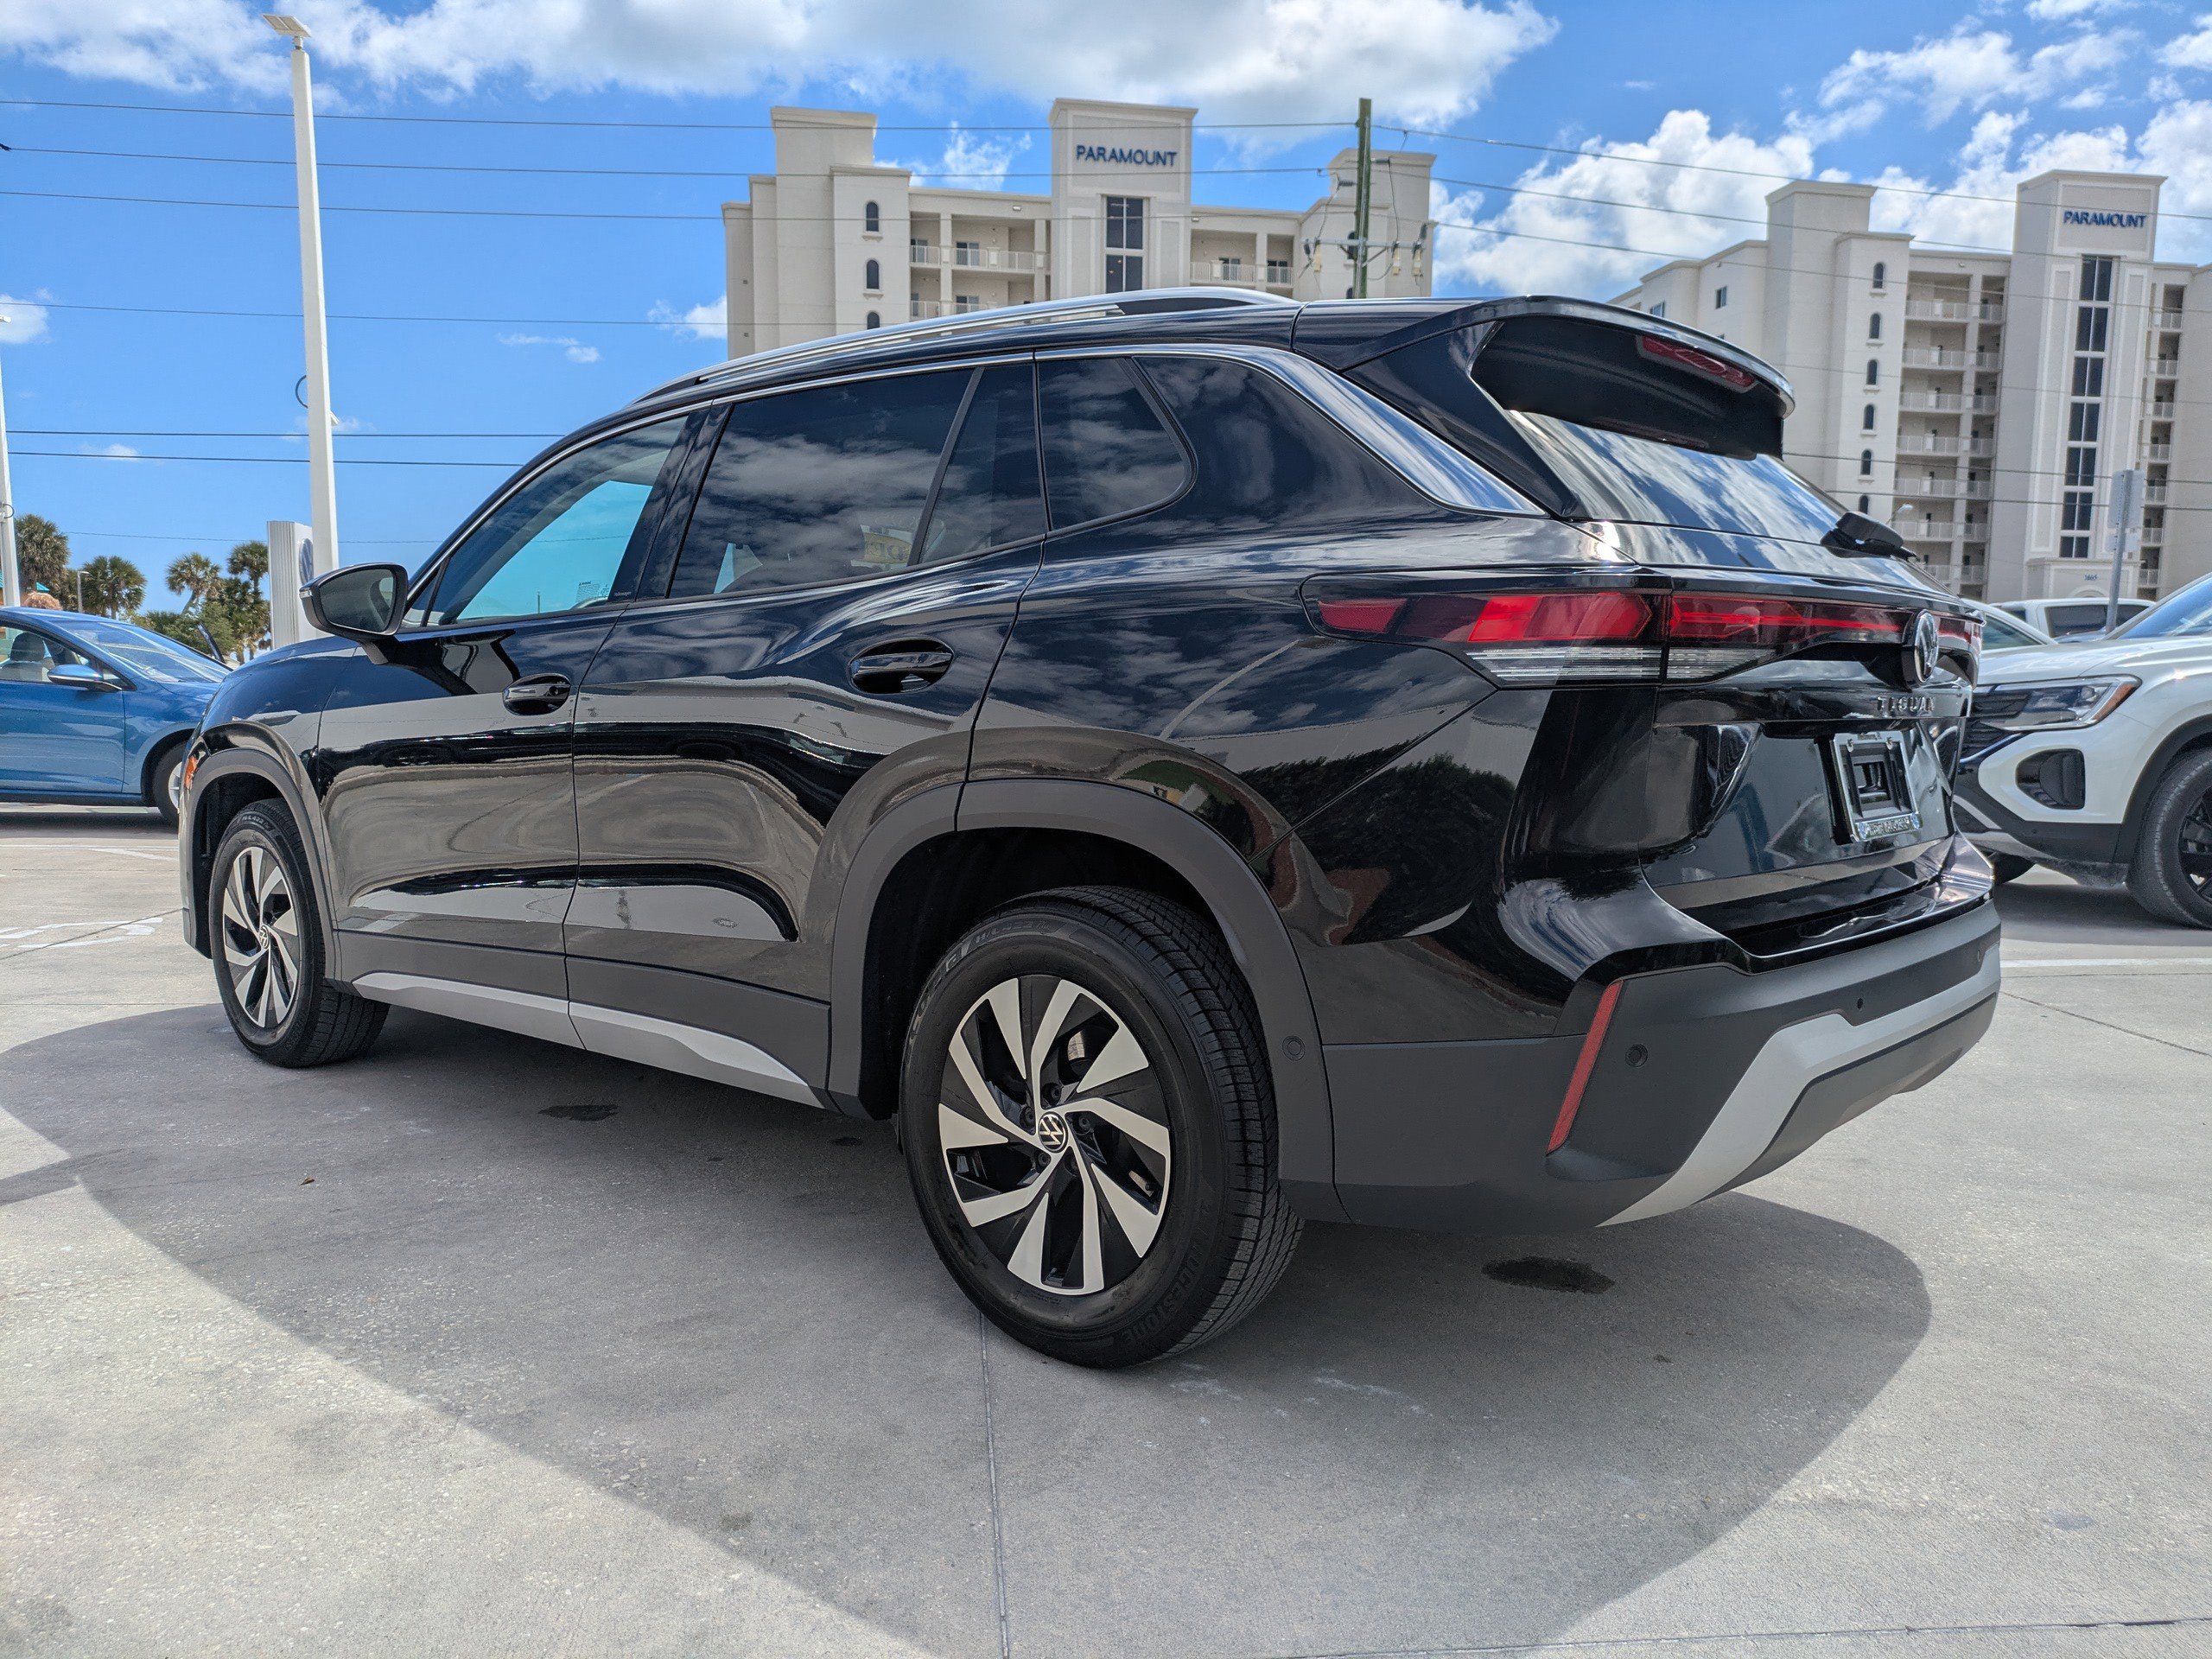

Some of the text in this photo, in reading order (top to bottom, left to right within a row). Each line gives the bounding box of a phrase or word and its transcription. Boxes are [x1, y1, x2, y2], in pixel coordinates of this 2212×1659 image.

[1076, 144, 1178, 167] PARAMOUNT
[2063, 210, 2147, 228] PARAMOUNT
[1877, 696, 1936, 712] TIGUAN
